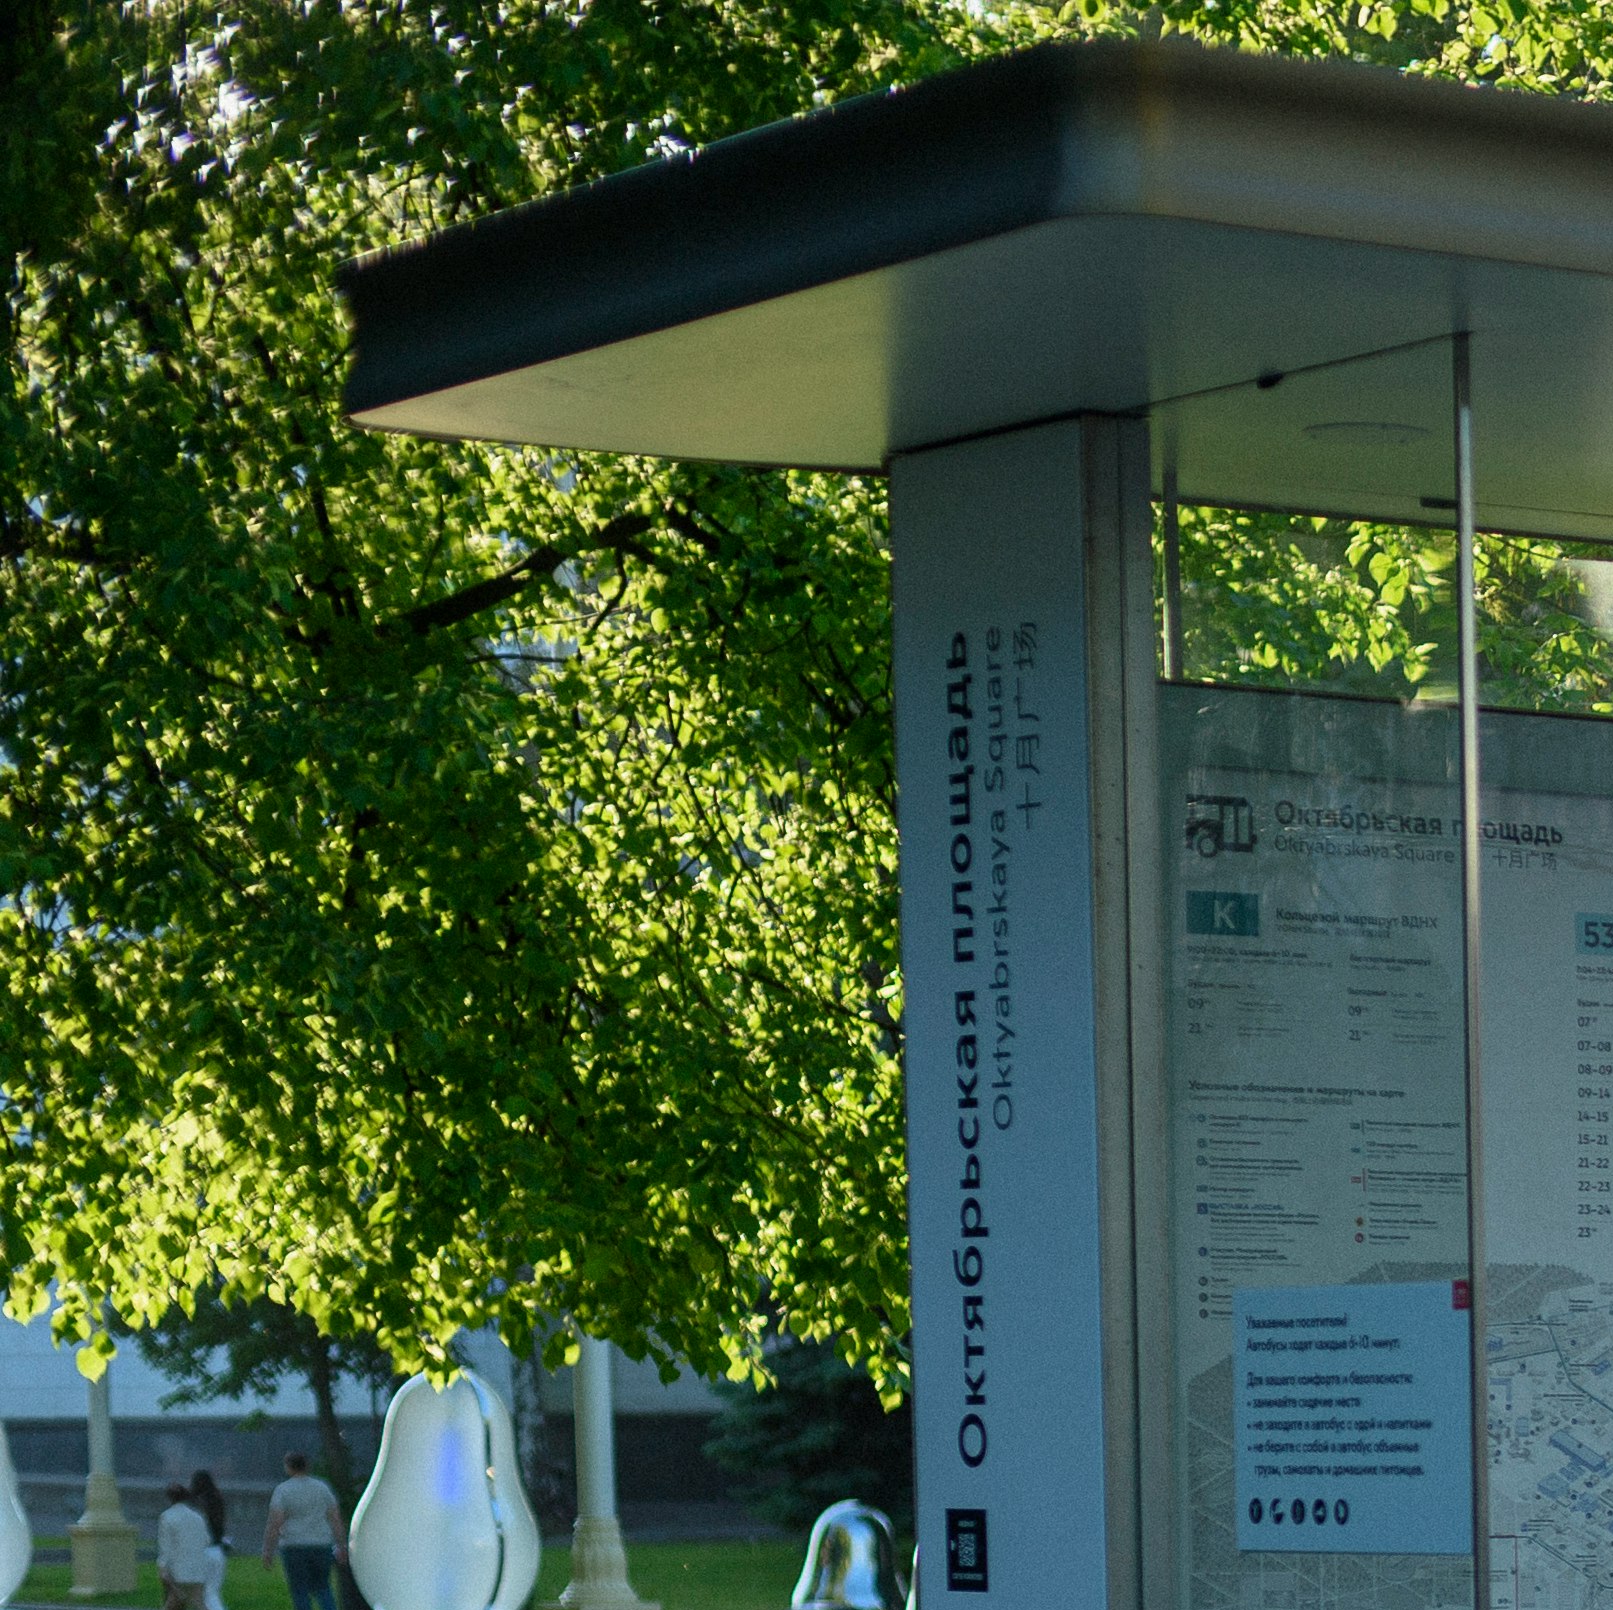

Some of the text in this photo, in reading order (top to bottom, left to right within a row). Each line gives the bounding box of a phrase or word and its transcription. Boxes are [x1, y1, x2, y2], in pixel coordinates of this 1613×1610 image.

[1014, 620, 1042, 830] 十月广场
[1275, 800, 1564, 848] Октябрьская пощадь
[984, 626, 1015, 1131] Oktyabrskaya Square
[1275, 834, 1454, 866] Oktyabrskaya Square
[945, 631, 990, 1468] Октябрьская площадь
